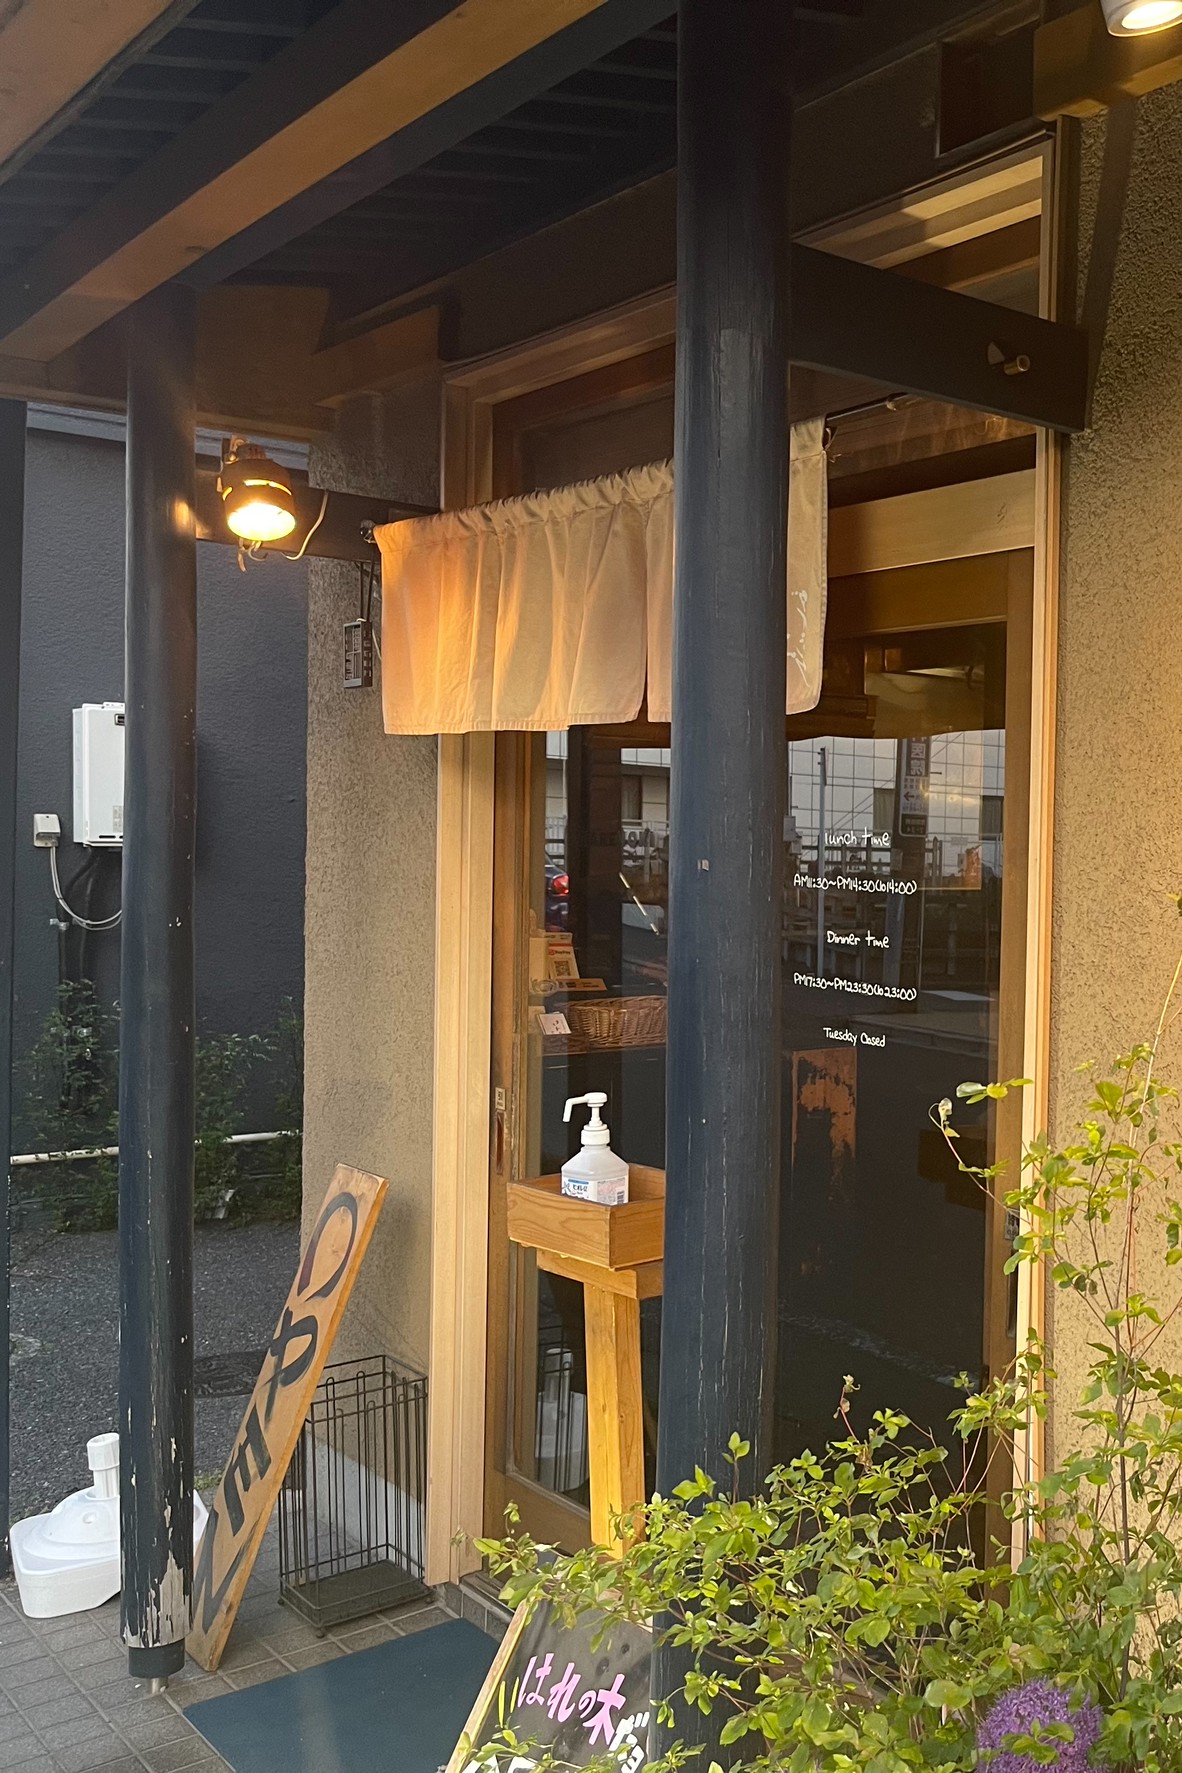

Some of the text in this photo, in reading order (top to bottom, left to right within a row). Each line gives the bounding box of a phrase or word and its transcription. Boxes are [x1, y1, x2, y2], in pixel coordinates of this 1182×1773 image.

[825, 830, 857, 845] lunch
[861, 826, 891, 846] time
[826, 930, 890, 948] Dinner time
[823, 1027, 886, 1048] Tuesday Closed
